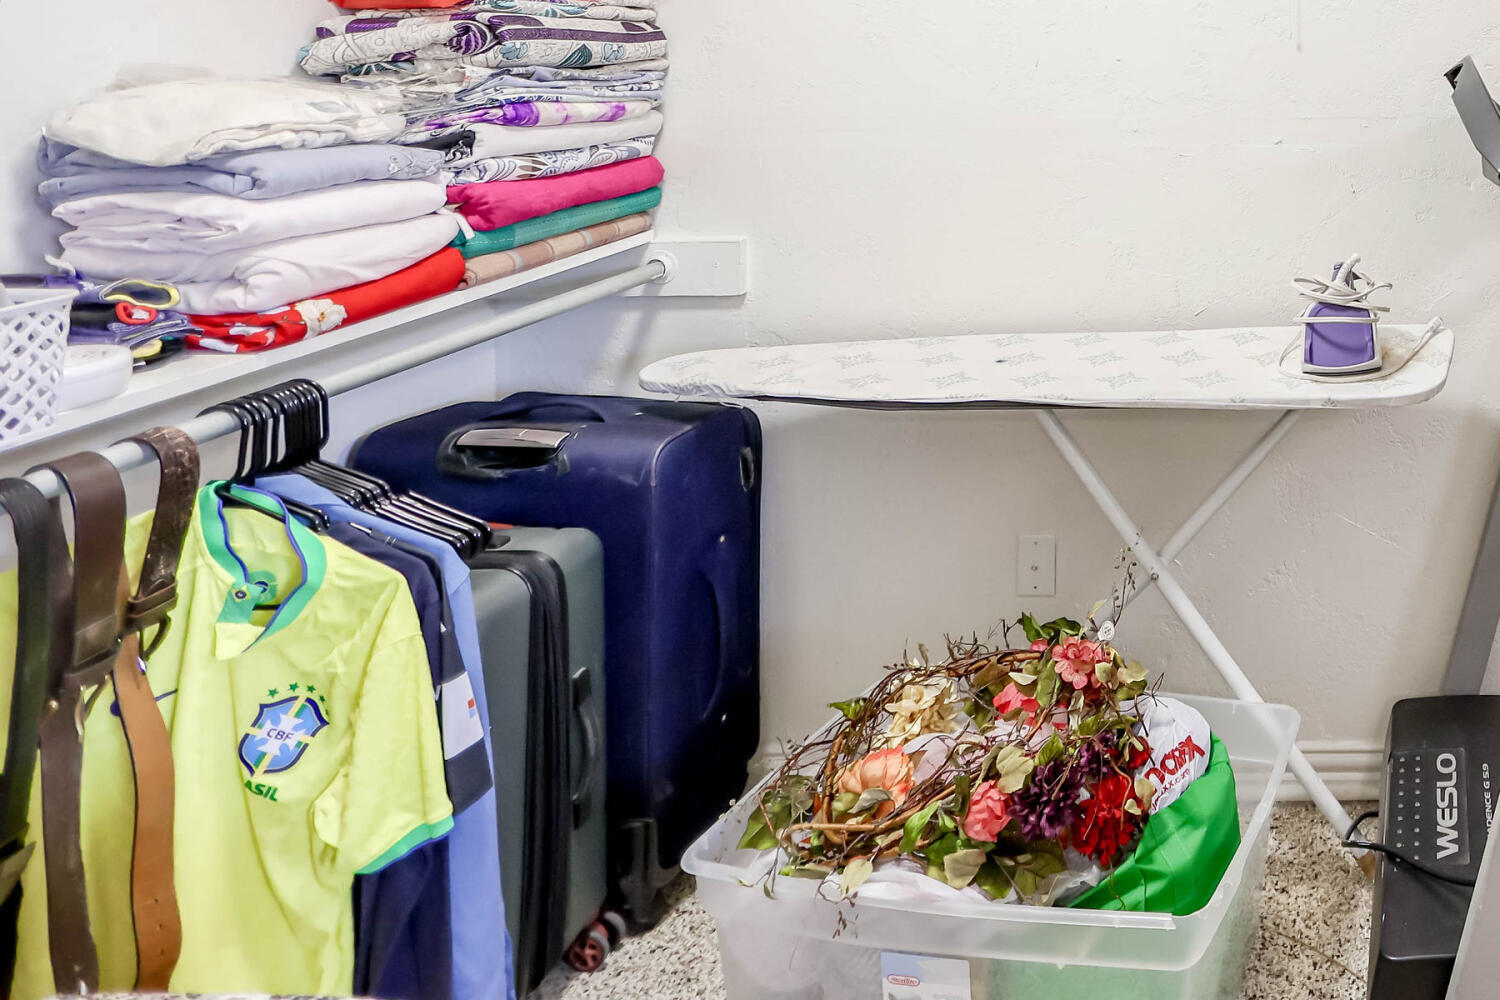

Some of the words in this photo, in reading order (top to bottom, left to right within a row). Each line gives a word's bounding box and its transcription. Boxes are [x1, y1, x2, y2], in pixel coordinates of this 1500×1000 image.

[266, 727, 295, 742] CBF
[1483, 780, 1491, 789] G
[1436, 753, 1459, 860] WESLO
[1484, 791, 1494, 834] ADENCE
